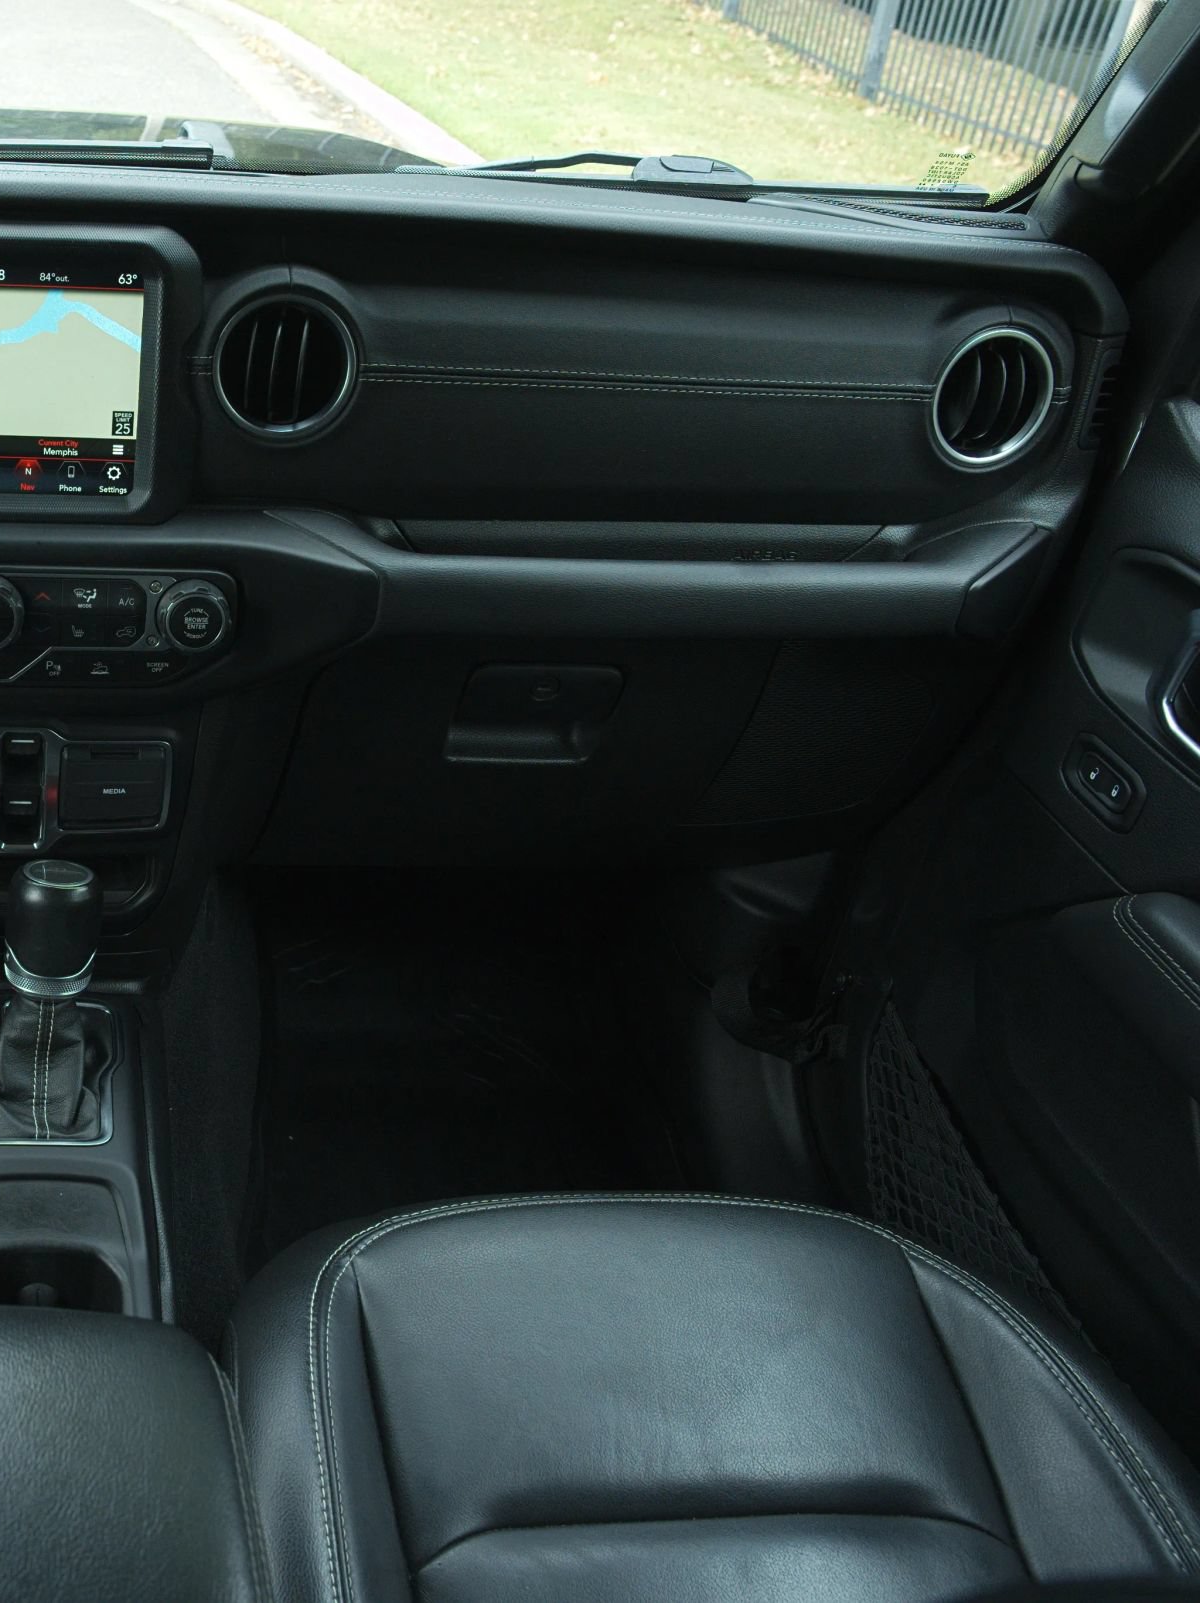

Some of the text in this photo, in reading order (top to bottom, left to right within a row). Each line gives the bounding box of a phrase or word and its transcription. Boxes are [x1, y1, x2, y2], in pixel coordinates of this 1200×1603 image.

[118, 274, 137, 285] 63°
[115, 424, 130, 434] 25
[64, 440, 78, 448] City
[43, 448, 78, 457] Memphis
[99, 486, 127, 494] Settings
[119, 598, 135, 606] A/C
